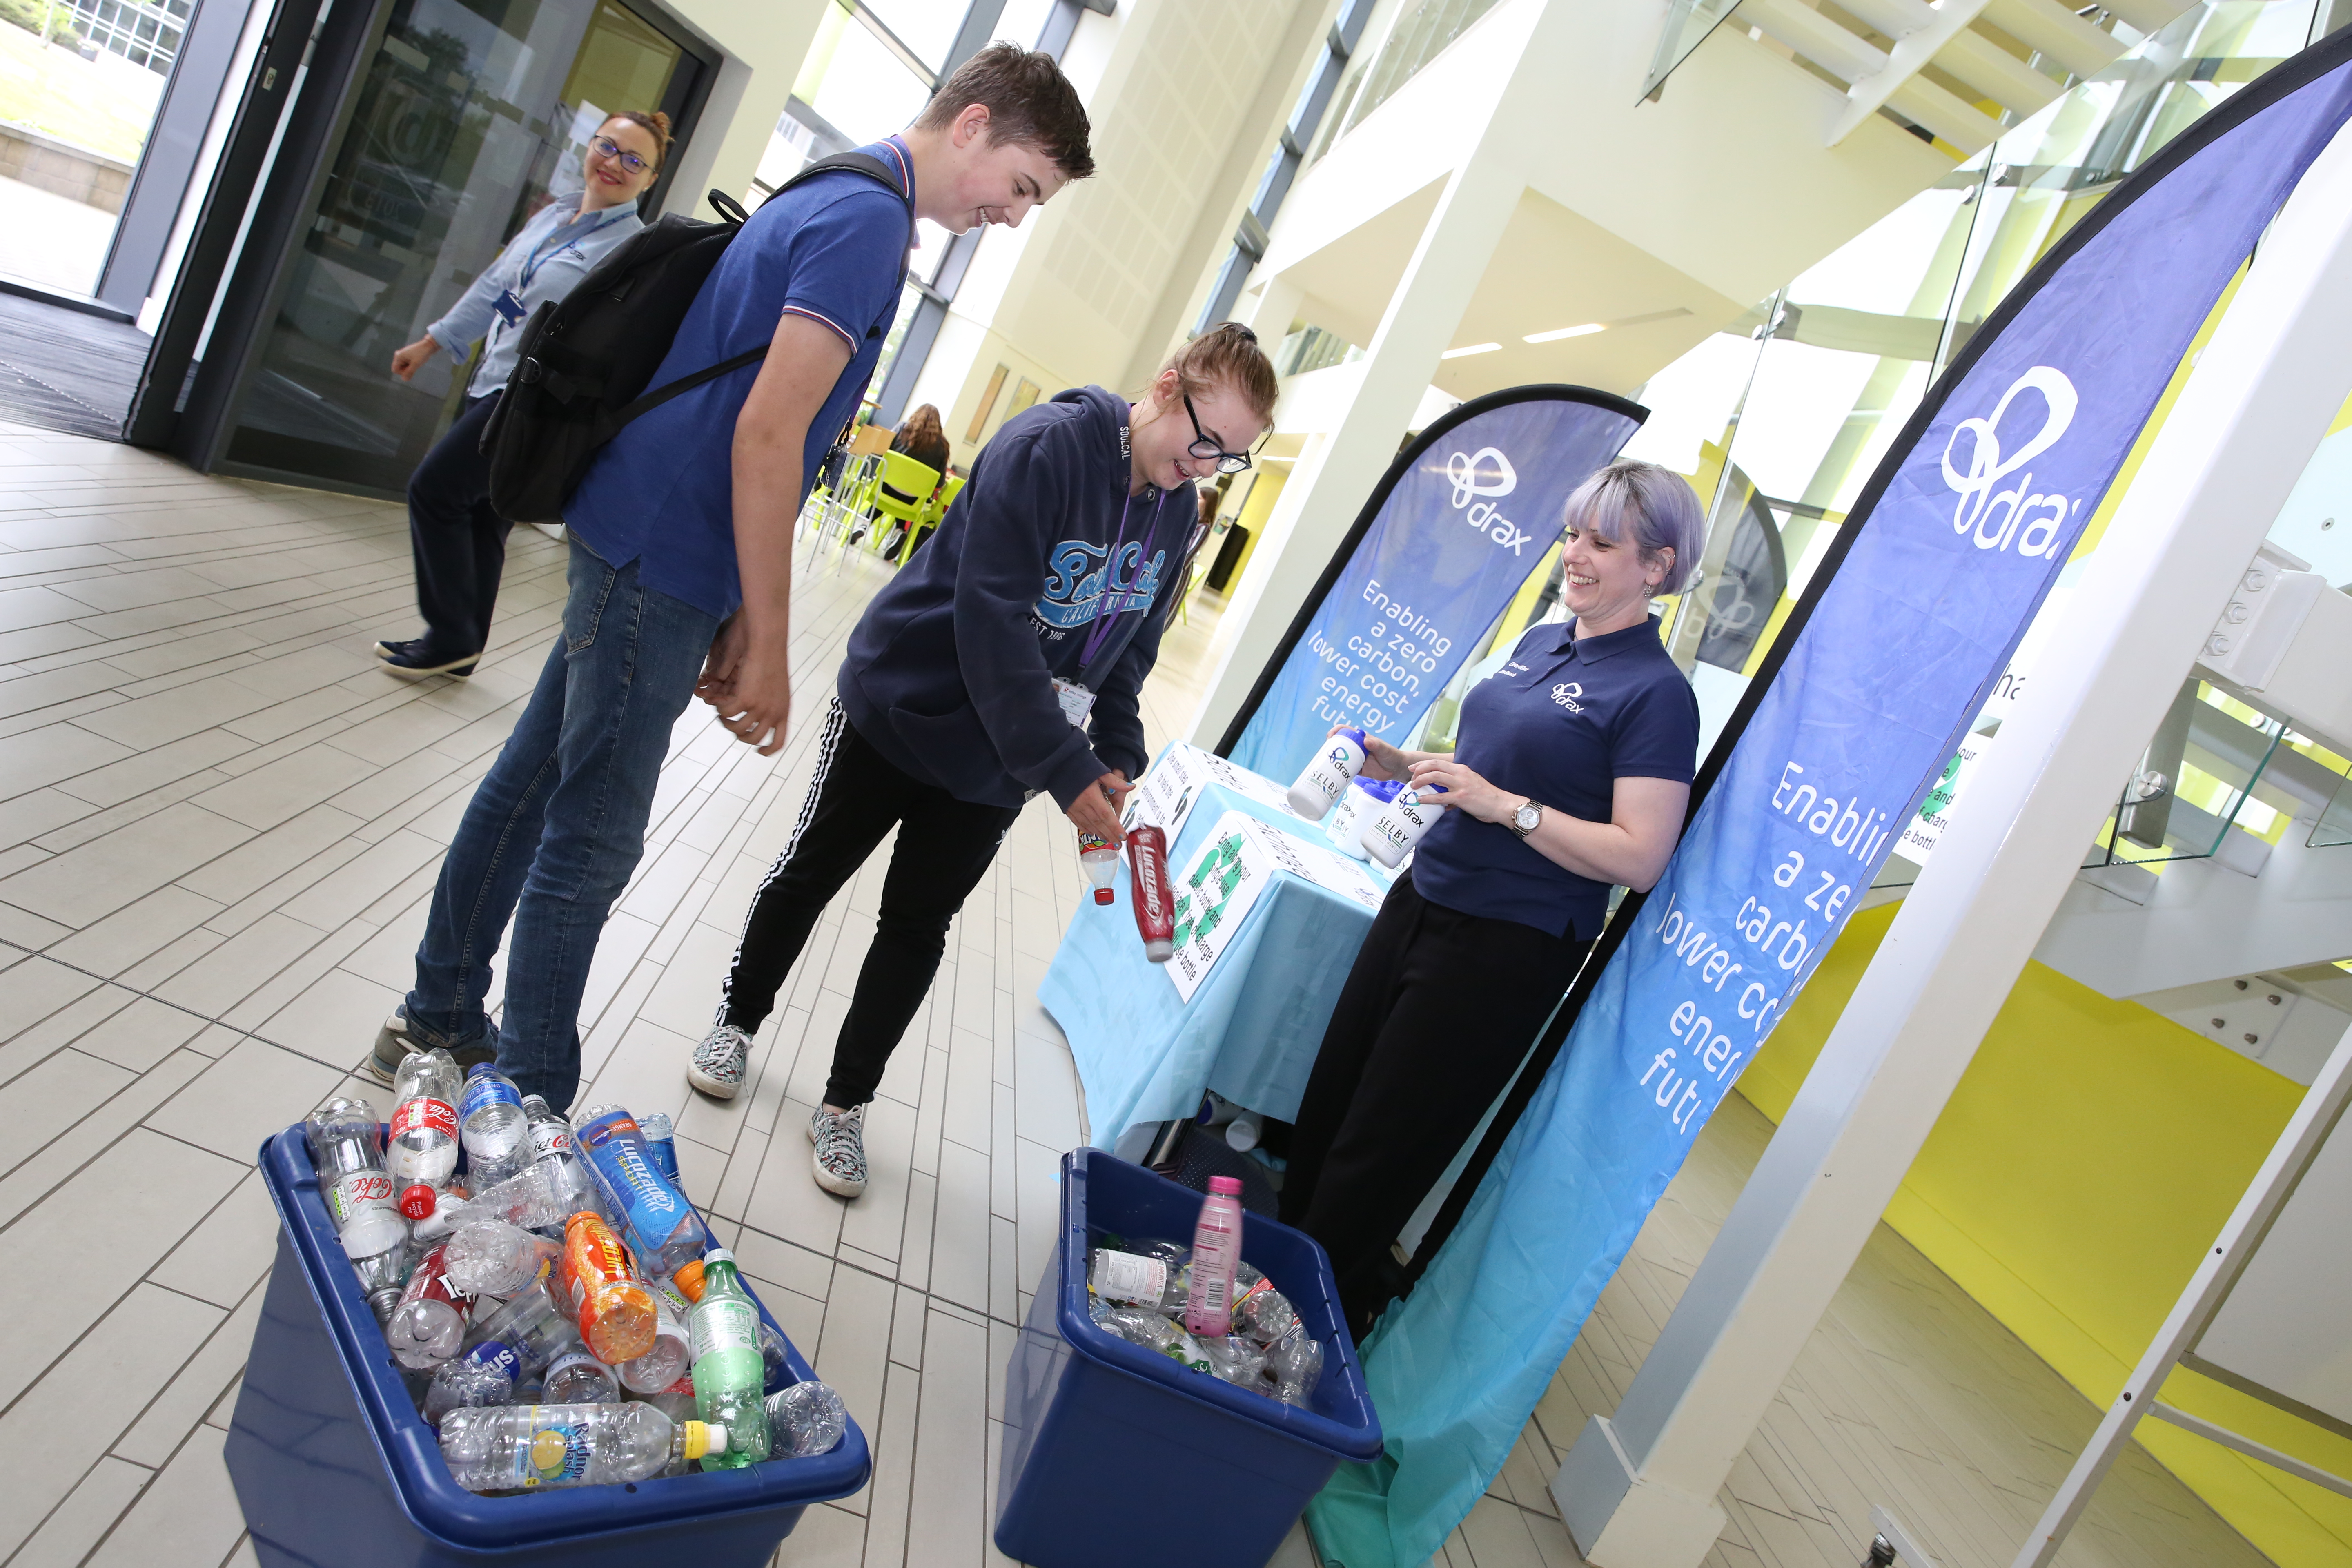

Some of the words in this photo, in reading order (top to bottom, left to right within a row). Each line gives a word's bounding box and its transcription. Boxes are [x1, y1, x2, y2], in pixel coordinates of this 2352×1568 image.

[1120, 426, 1130, 460] SOULCAL
[1467, 502, 1532, 556] drax
[1973, 472, 2082, 560] dra
[1363, 579, 1452, 657] Enabling
[1371, 621, 1386, 638] a
[1388, 634, 1436, 673] zero
[1307, 630, 1360, 677] lower
[1360, 675, 1409, 714] cost
[1348, 635, 1420, 698] carbon,
[1321, 676, 1395, 733] energy
[1555, 696, 1585, 714] drax
[1157, 771, 1164, 783] to
[1160, 775, 1170, 794] help
[1167, 751, 1176, 766] One
[1173, 760, 1185, 775] small
[1179, 770, 1189, 786] step
[1311, 770, 1339, 795] SELBY
[1334, 762, 1351, 782] drax
[1141, 785, 1161, 815] environment
[1158, 813, 1166, 825] to
[1165, 785, 1174, 799] the
[1933, 791, 1956, 806] and
[1379, 817, 1409, 844] SELBY
[1403, 808, 1424, 829] drax
[1218, 832, 1233, 858] Bring
[1227, 847, 1242, 873] along
[1235, 862, 1251, 883] your
[1385, 839, 1399, 853] COUNCIL
[1142, 846, 1162, 914] Lucozade
[1208, 862, 1223, 884] single
[1218, 879, 1230, 897] use
[1774, 851, 1804, 887] a
[1181, 903, 1191, 917] it
[1187, 873, 1203, 898] plastic
[1198, 890, 1213, 915] bottle
[1209, 910, 1223, 929] and
[1184, 909, 1195, 930] free
[1191, 924, 1202, 936] of
[1194, 932, 1213, 962] charge
[1656, 892, 1742, 992] lower
[1174, 942, 1184, 959] use
[1180, 952, 1196, 981] bottle
[476, 1083, 501, 1092] SPRING
[430, 1105, 456, 1124] Cola
[434, 1124, 451, 1134] TASTE
[612, 1122, 632, 1131] ORANGE
[535, 1137, 552, 1151] iet
[617, 1156, 644, 1191] SPORT
[619, 1139, 670, 1204] Lucozade
[350, 1177, 392, 1205] Coke
[590, 1225, 627, 1276] Lucozade
[563, 1434, 577, 1473] splash
[572, 1422, 592, 1481] Radnor
